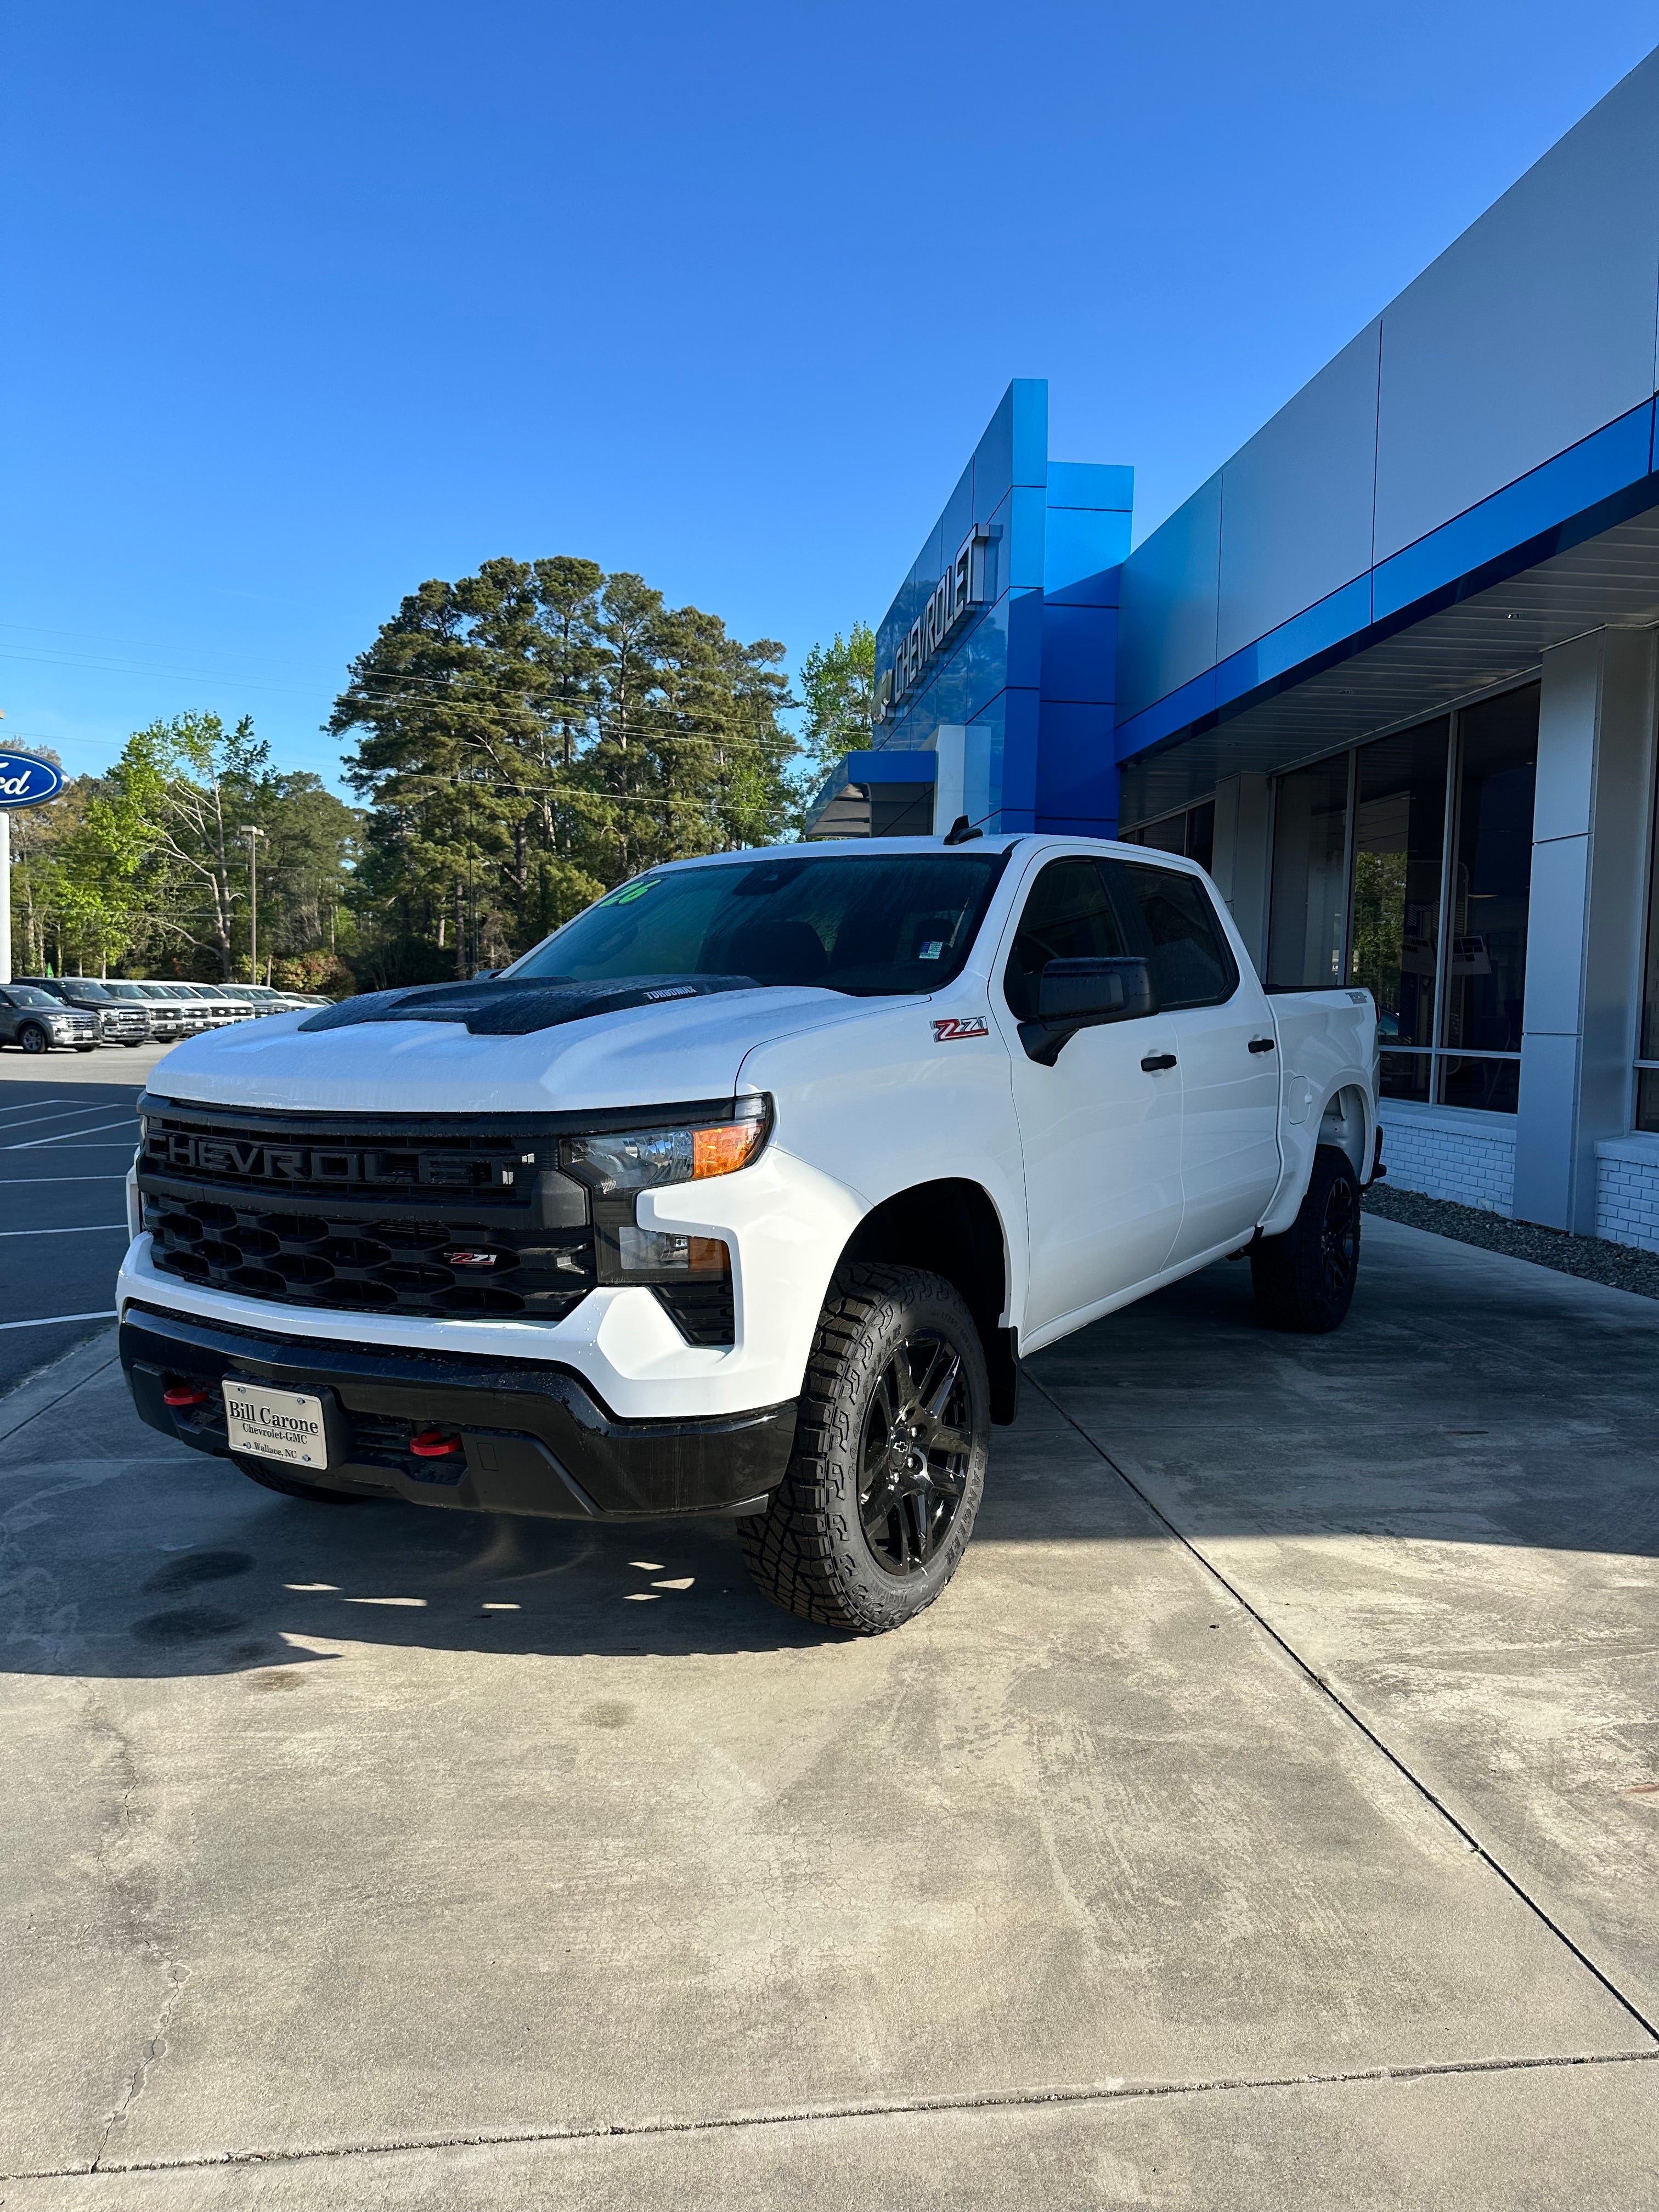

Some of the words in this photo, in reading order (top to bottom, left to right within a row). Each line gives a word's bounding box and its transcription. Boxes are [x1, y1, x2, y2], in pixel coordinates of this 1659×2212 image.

[895, 523, 990, 704] CHEVROLET
[597, 879, 662, 908] 26
[641, 985, 697, 1000] TURBOMAX
[930, 1016, 989, 1043] Z71
[146, 1132, 535, 1186] CHEVROLET
[450, 1252, 497, 1265] Z71
[229, 1400, 256, 1421] Bill
[261, 1406, 319, 1434] Carone
[243, 1423, 308, 1444] Chevrolet-GMC
[253, 1442, 284, 1457] Wallace,
[285, 1448, 297, 1458] NC
[945, 1430, 988, 1567] WRANGLER
